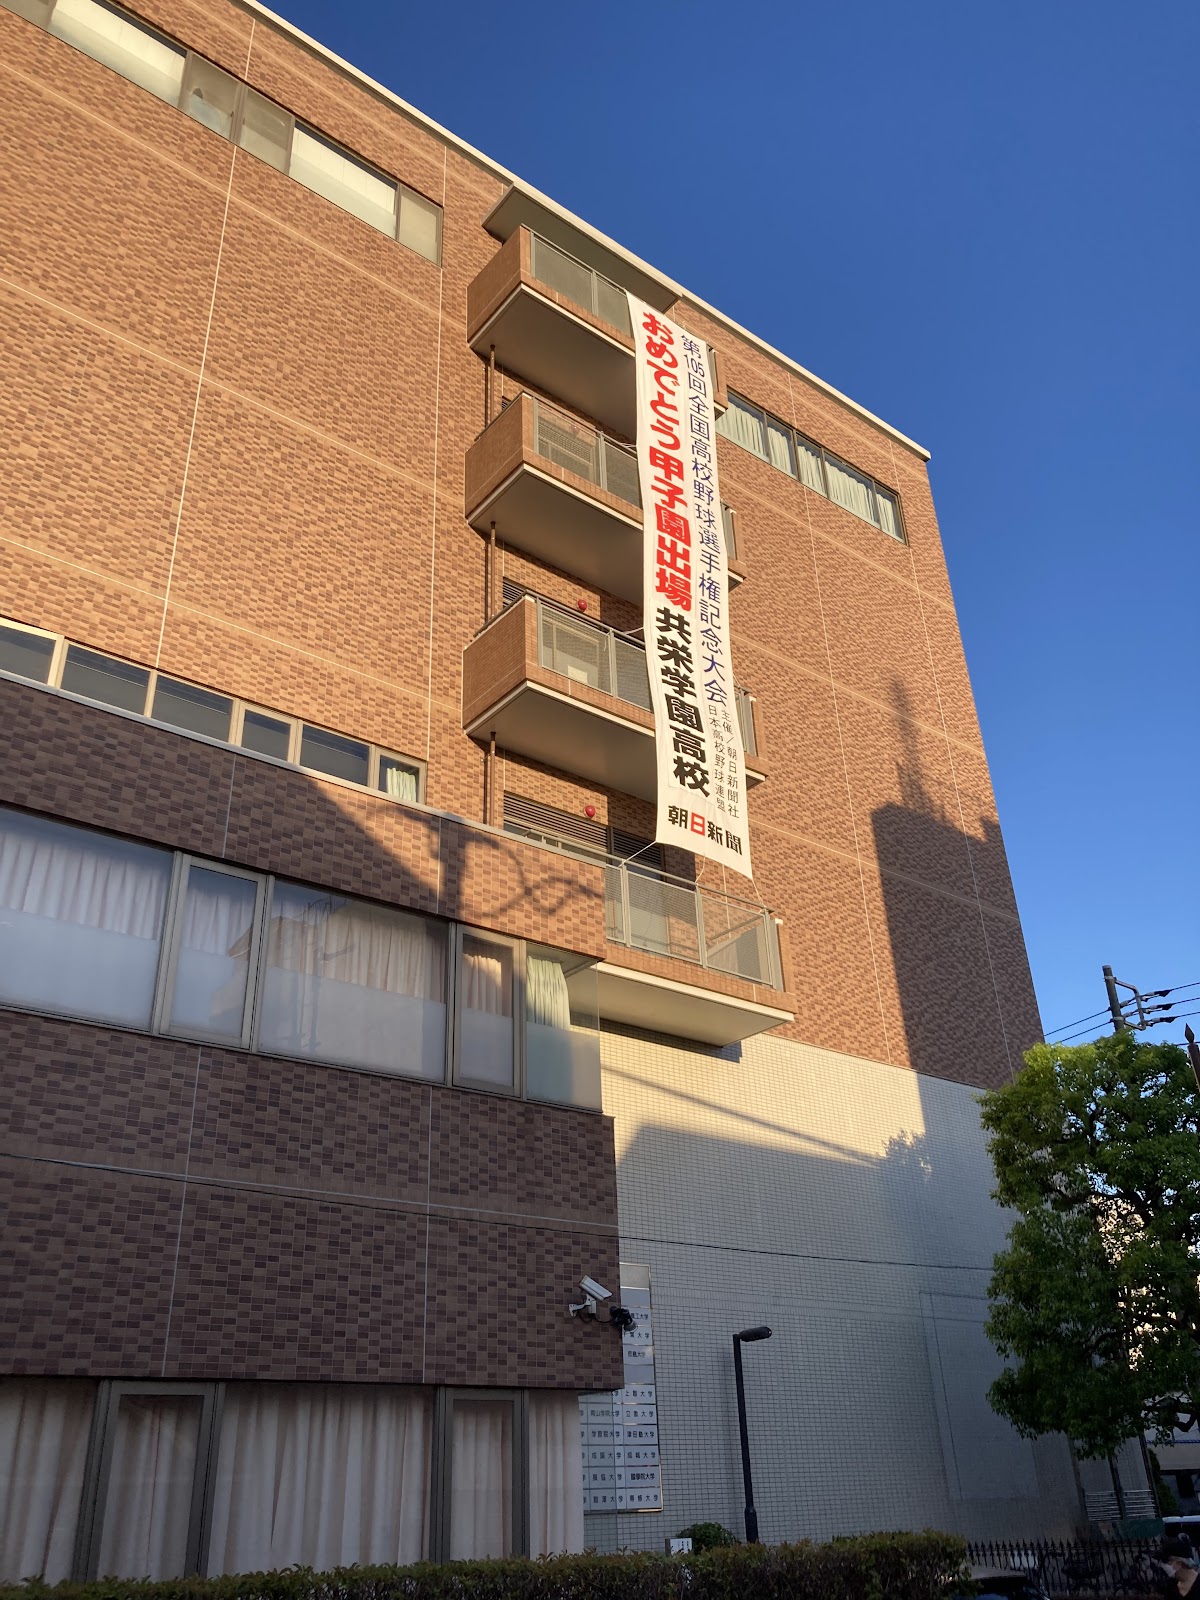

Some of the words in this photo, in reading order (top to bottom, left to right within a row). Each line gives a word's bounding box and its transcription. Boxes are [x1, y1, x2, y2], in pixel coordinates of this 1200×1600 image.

[681, 334, 728, 707] 第105回全国高校野球選手権記念大会
[708, 704, 726, 813] 日本高校野球連盟
[668, 804, 743, 856] 朝日新聞
